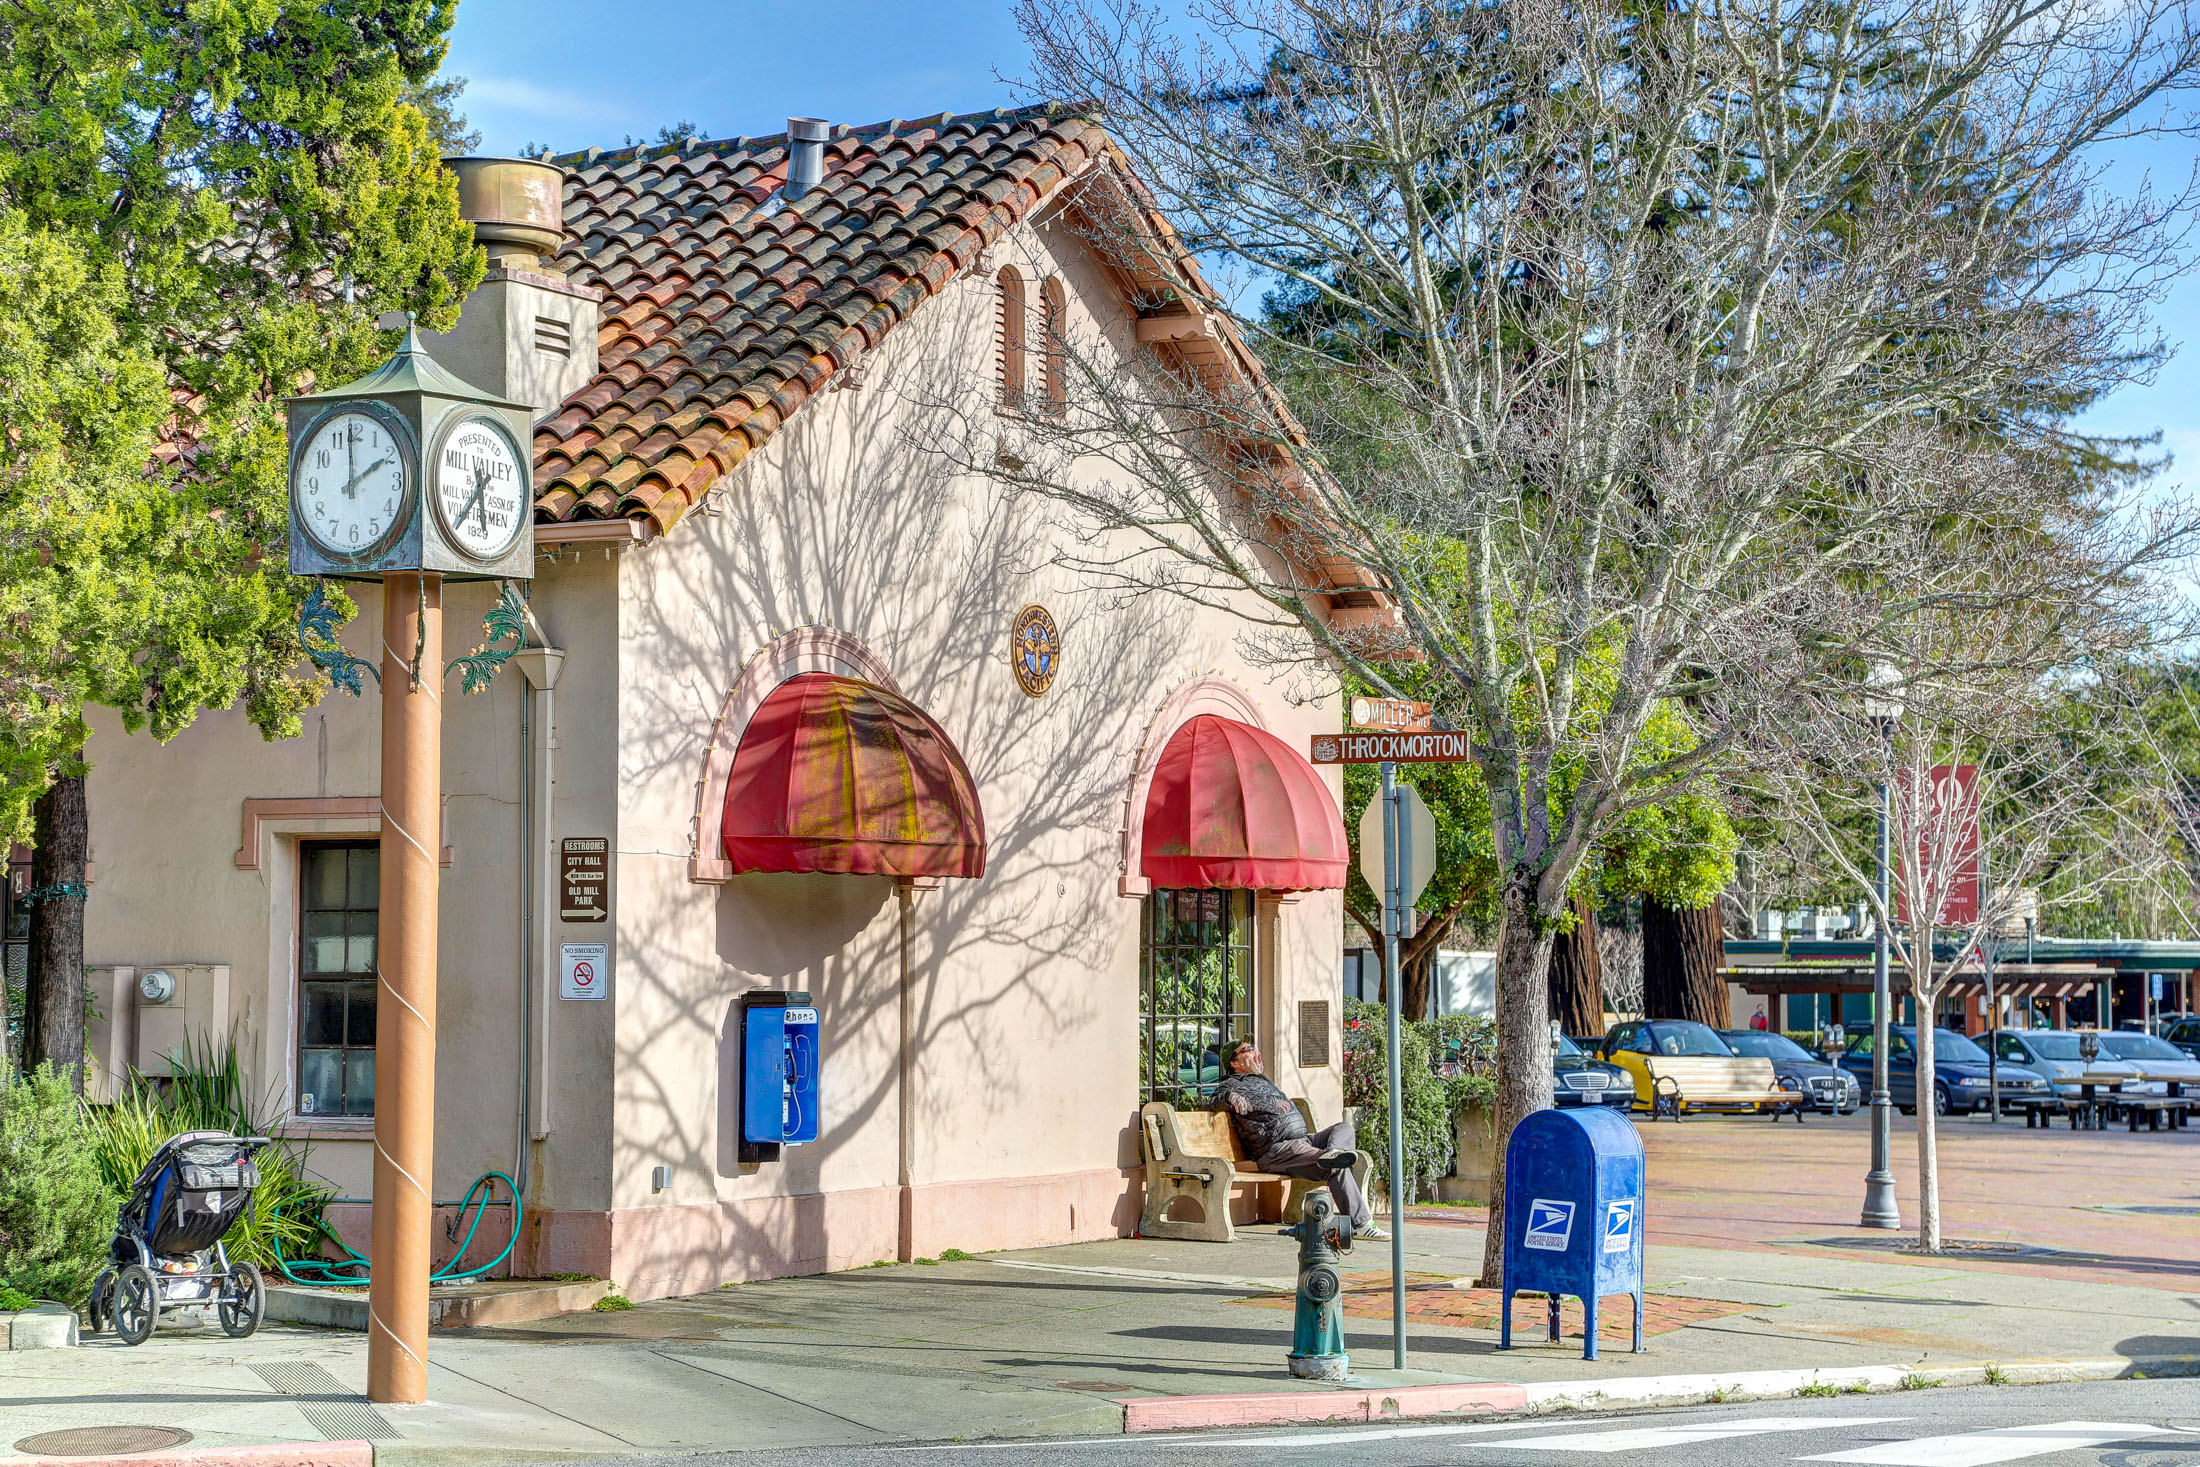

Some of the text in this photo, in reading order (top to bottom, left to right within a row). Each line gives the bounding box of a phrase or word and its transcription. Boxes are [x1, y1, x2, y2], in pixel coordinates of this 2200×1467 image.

[332, 431, 344, 450] 11
[372, 430, 378, 448] 1
[458, 433, 501, 457] PRESENTED
[316, 449, 330, 469] 10
[385, 446, 396, 465] 2
[476, 446, 484, 454] TO
[445, 449, 512, 482] MILL VALLEY
[308, 477, 319, 496] 9
[392, 472, 402, 491] 3
[442, 483, 460, 499] MILL
[466, 475, 475, 488] By
[315, 501, 325, 520] 8
[383, 497, 394, 517] 4
[329, 519, 339, 538] 7
[349, 524, 359, 544] 6
[369, 518, 380, 536] 5
[467, 525, 489, 540] 1929
[1016, 609, 1058, 655] NORTHWESTERN
[1018, 660, 1056, 691] PACIFIC
[1370, 702, 1428, 728] MILLER AVE
[1339, 735, 1465, 759] THROCKMORTON
[564, 841, 605, 850] RESTROOMS
[567, 856, 601, 866] CITY HALL
[568, 886, 599, 896] OLD MILL
[574, 896, 593, 905] PARK
[1527, 1239, 1565, 1249] POSTAL SERVICE
